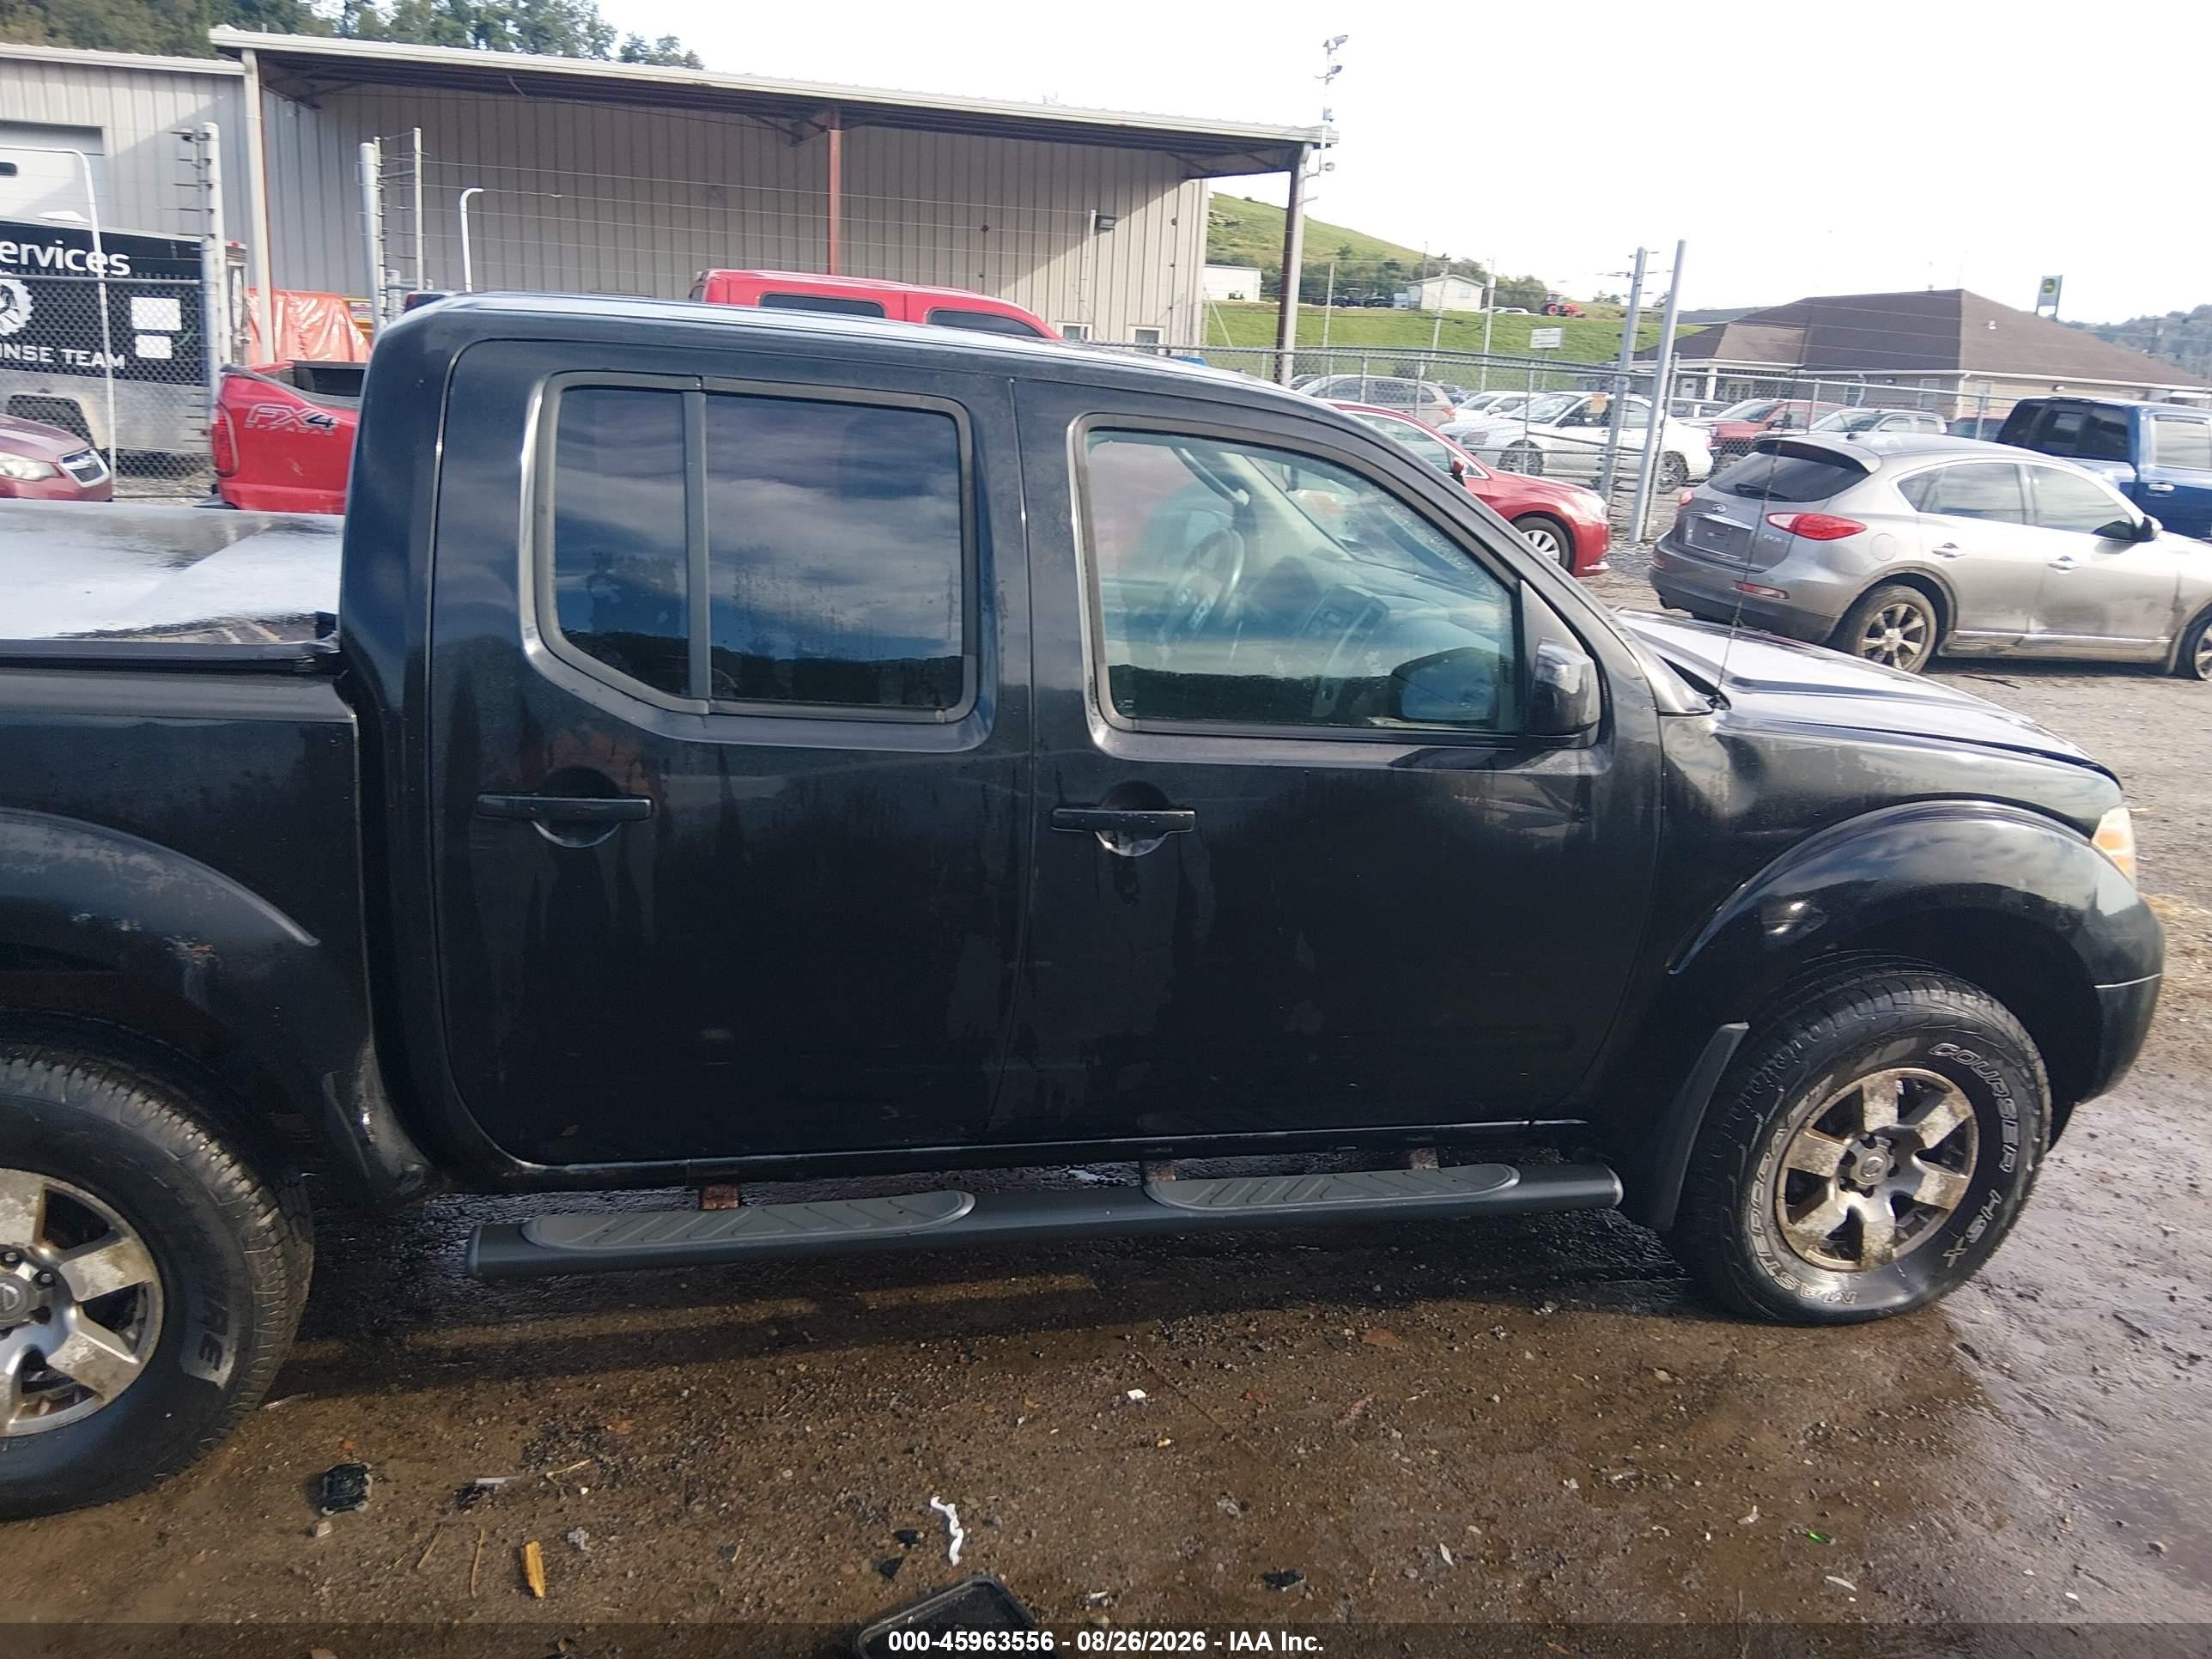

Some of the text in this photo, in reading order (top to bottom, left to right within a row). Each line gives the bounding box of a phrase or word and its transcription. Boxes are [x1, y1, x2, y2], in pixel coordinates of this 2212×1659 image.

[0, 343, 125, 369] NSE TEAM
[246, 403, 338, 429] FX4
[1929, 1042, 2019, 1174] COURSER
[1942, 1188, 2003, 1268] HSX
